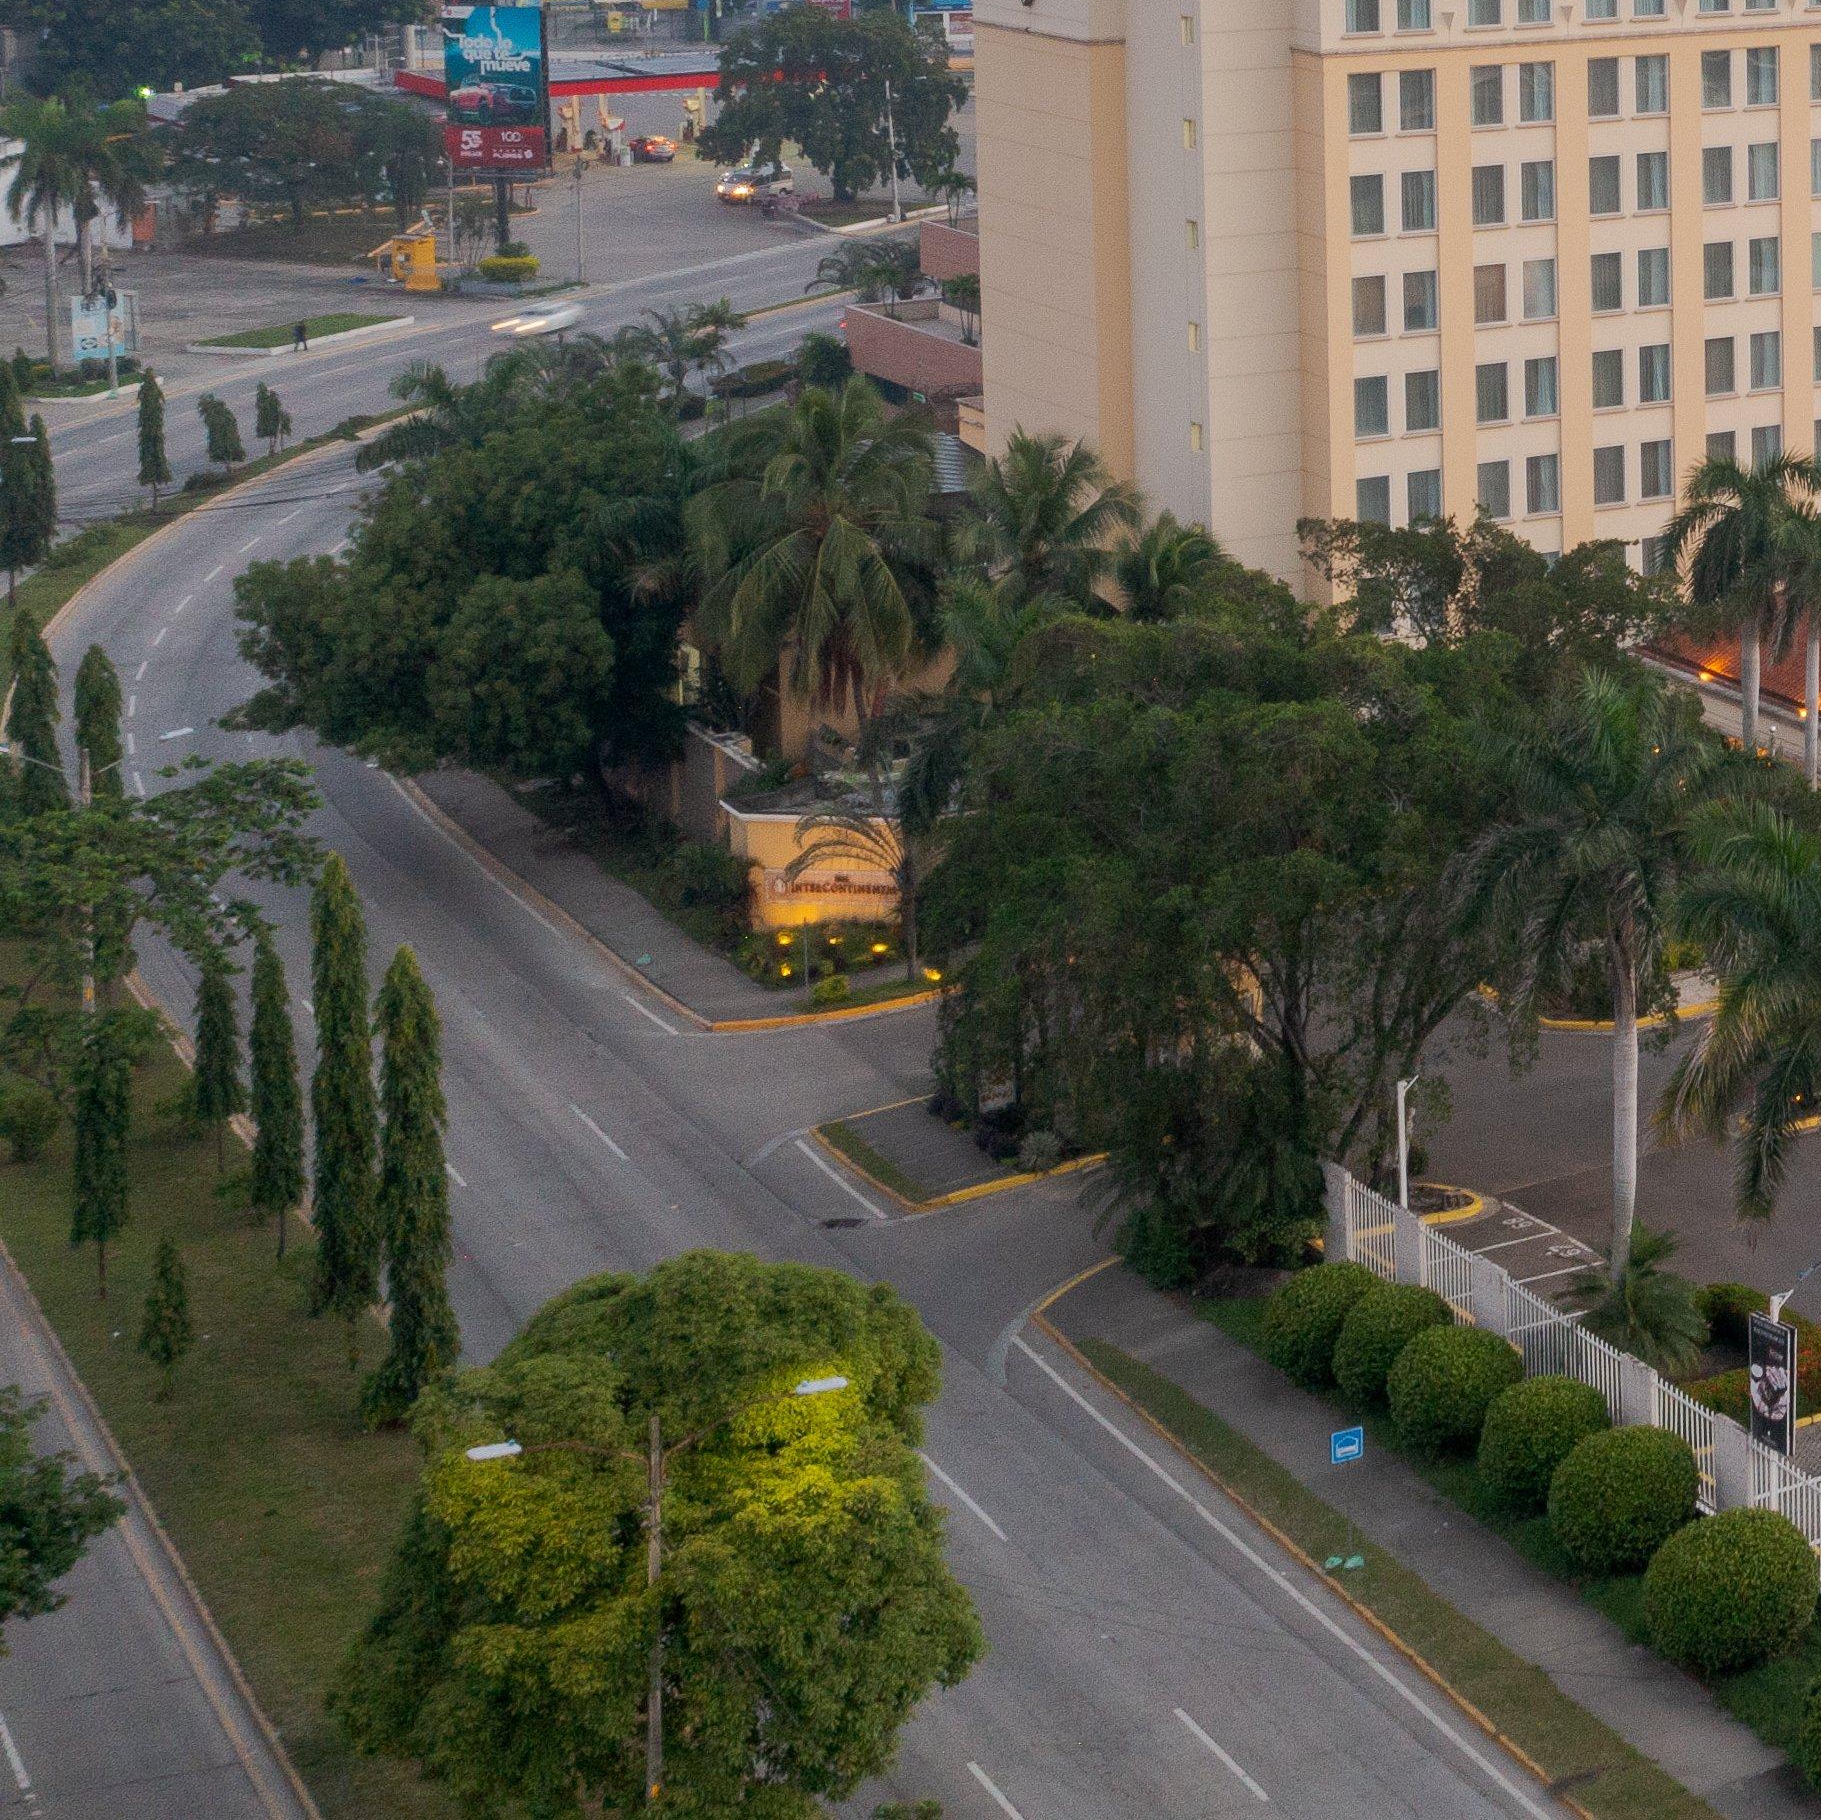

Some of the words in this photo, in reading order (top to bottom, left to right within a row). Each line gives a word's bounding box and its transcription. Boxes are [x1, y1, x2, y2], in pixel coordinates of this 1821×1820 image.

[460, 34, 493, 49] Todo
[463, 48, 491, 63] que
[481, 60, 530, 75] mueve
